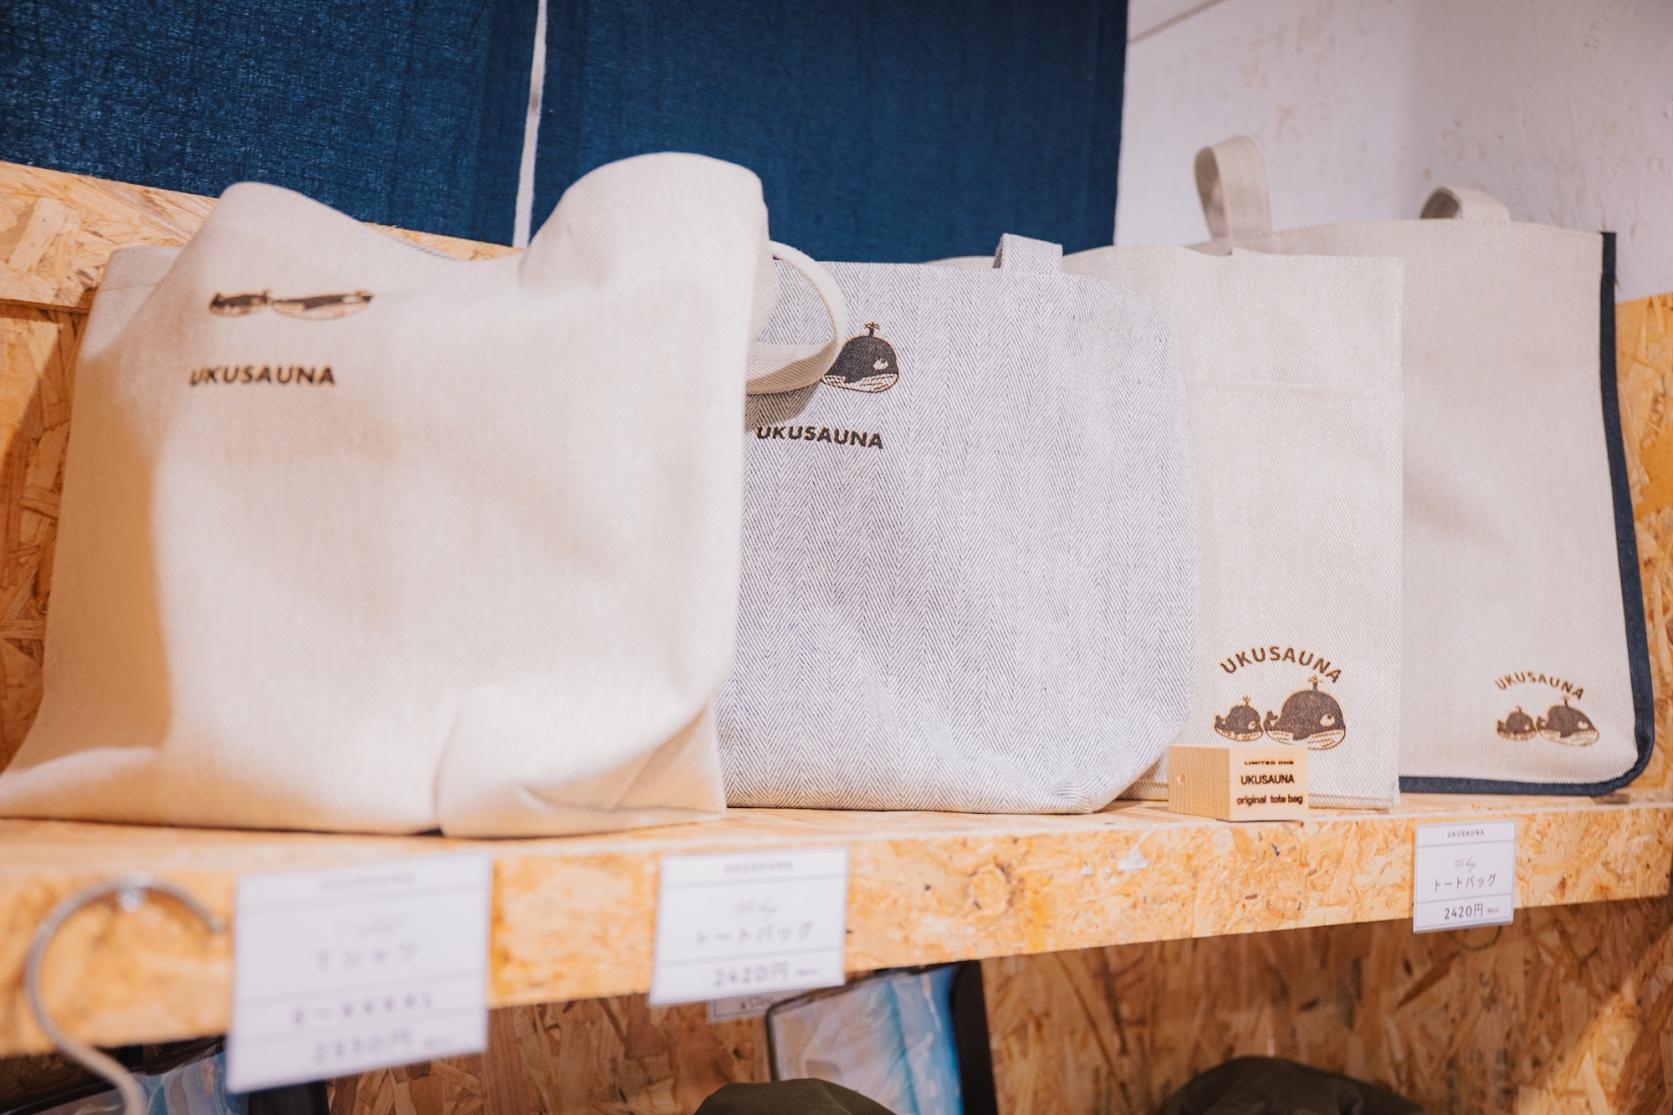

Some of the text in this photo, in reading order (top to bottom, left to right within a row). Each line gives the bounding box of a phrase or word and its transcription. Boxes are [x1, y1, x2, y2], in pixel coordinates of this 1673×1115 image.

[190, 365, 335, 387] UKUSAUNA
[757, 425, 883, 449] UKUSAUNA
[1220, 645, 1342, 683] UKUSAUNA
[1495, 671, 1584, 700] UKUSAUNA
[1240, 774, 1295, 786] UKUSAUNA
[1236, 794, 1303, 807] original tote bag
[1434, 873, 1497, 892] トートバッグ
[1444, 903, 1484, 920] 2420円
